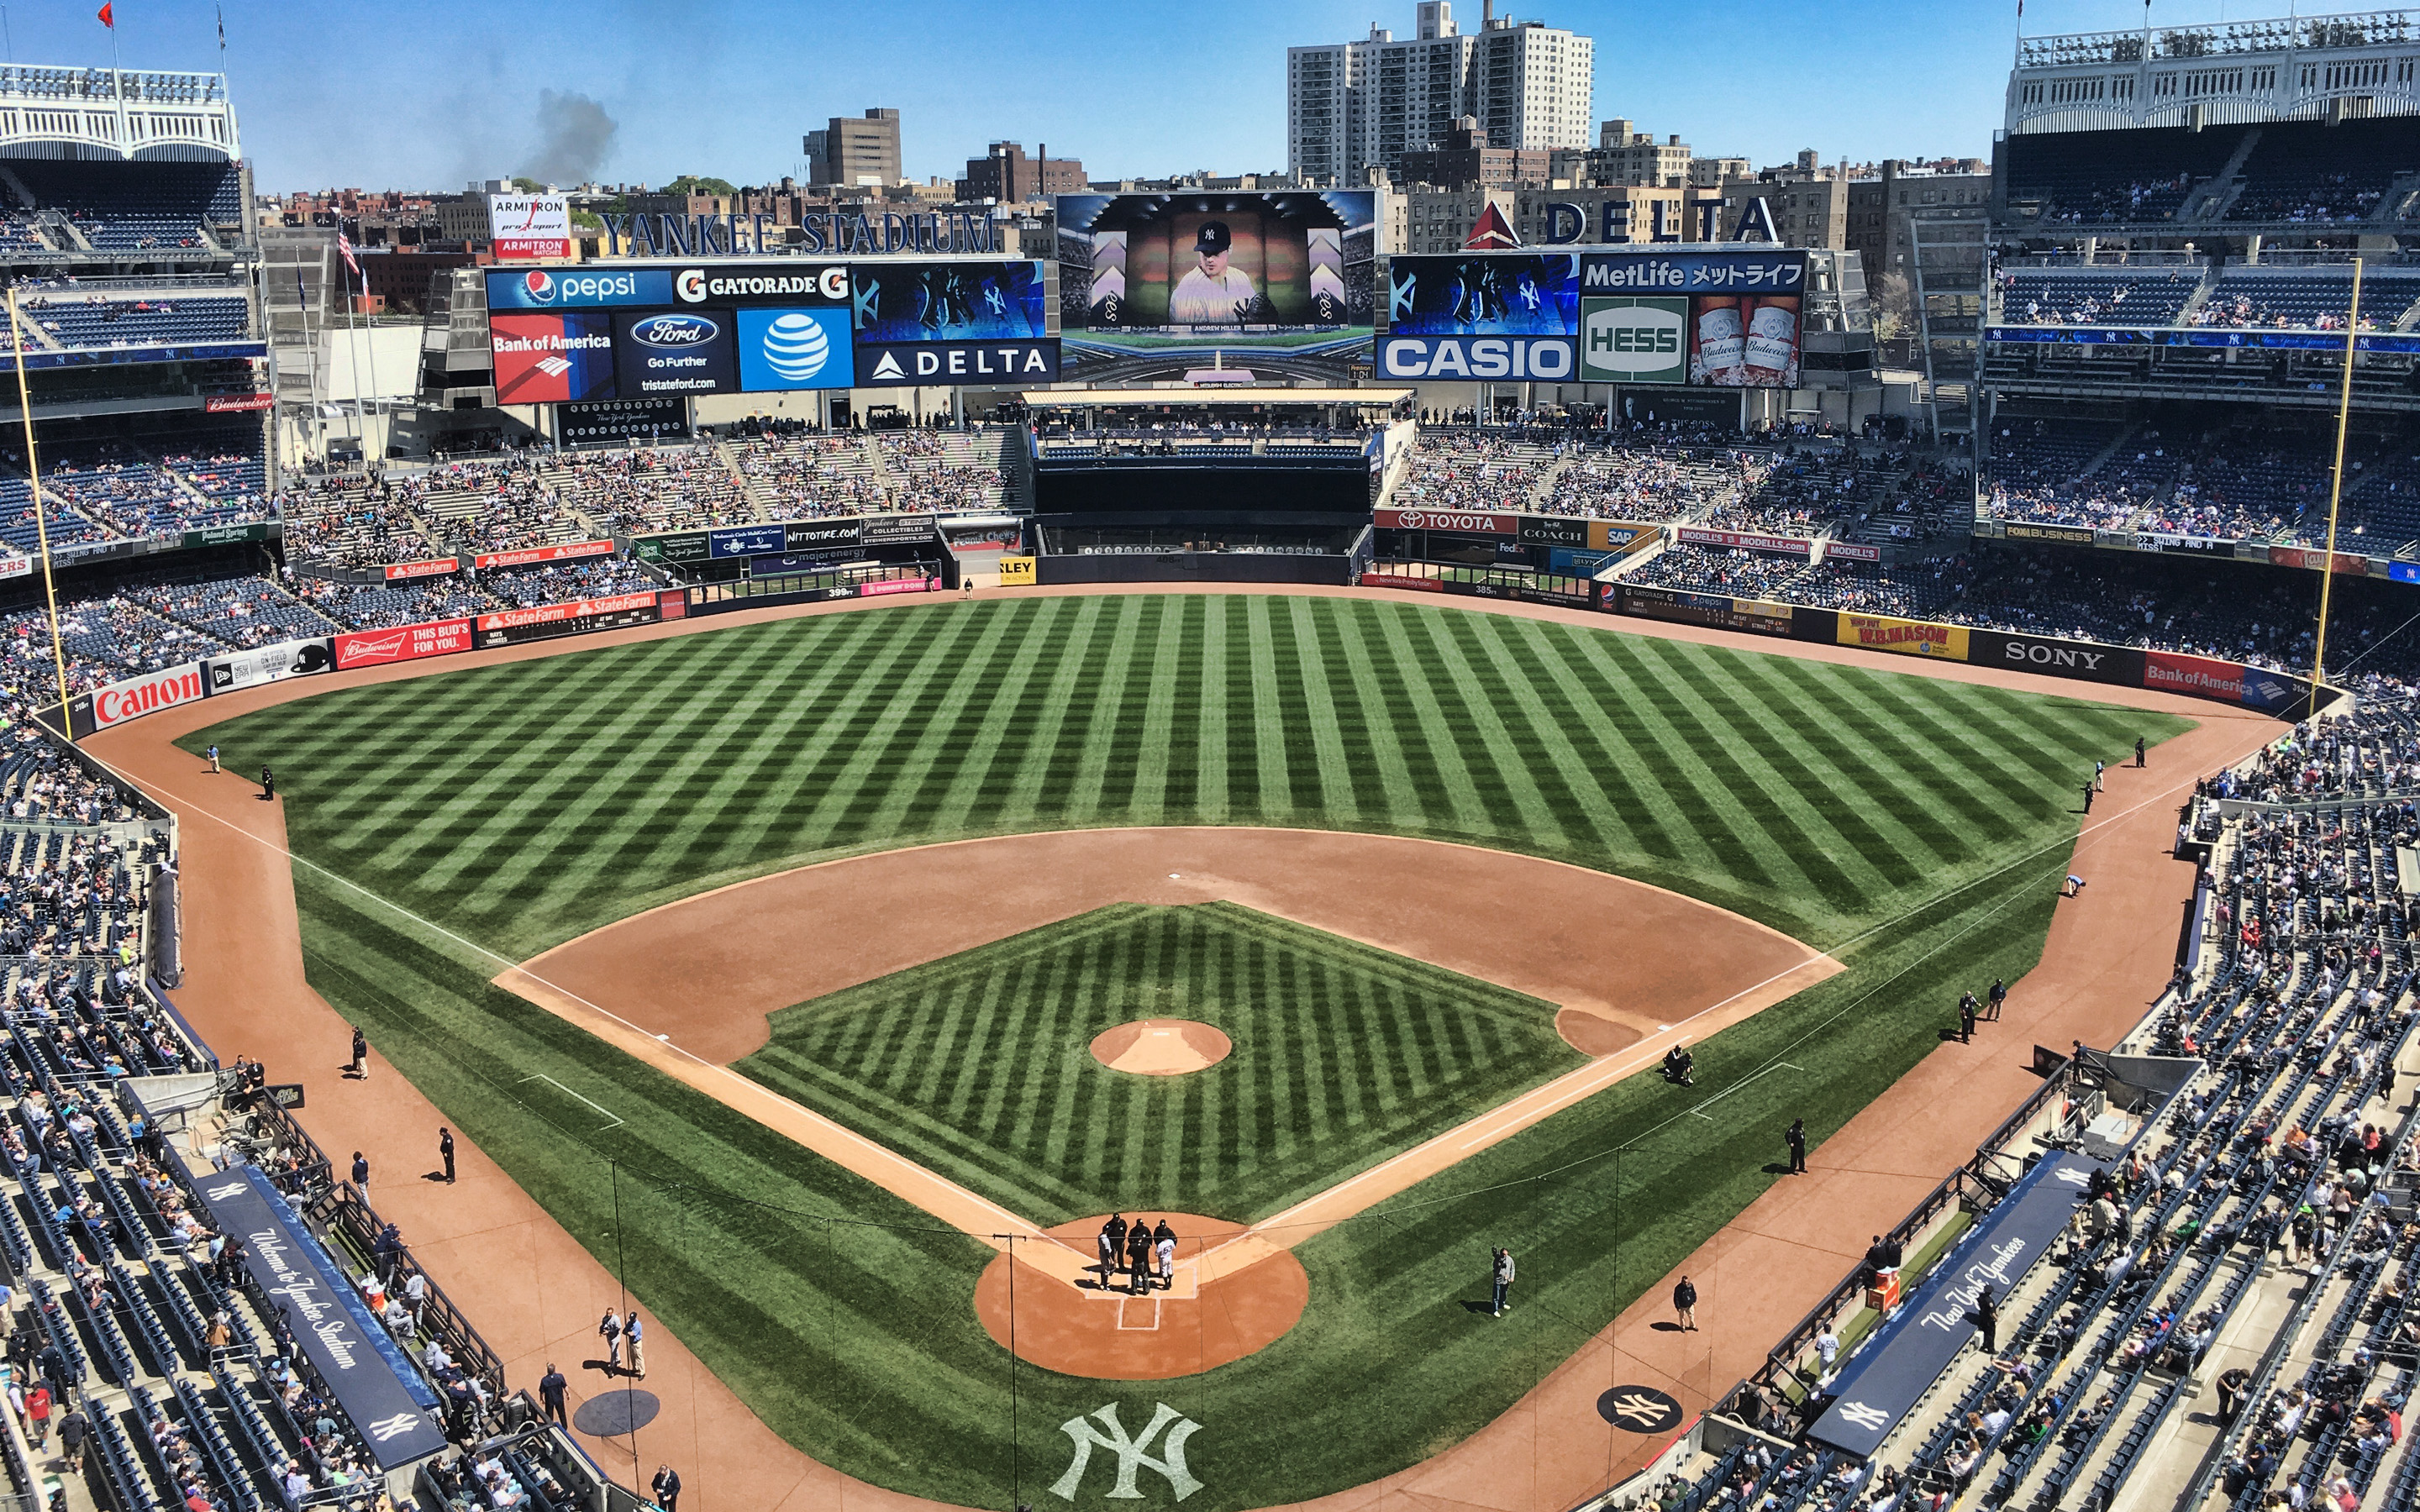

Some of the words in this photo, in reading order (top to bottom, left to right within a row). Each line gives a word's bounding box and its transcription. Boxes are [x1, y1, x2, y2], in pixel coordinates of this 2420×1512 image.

[496, 202, 562, 212] ARMITRON
[1547, 197, 1779, 244] DELTA
[597, 213, 777, 256] YANKEE
[801, 213, 998, 253] STADIUM
[502, 241, 562, 250] ARMITRON
[1585, 261, 1684, 286] MetLife
[1693, 264, 1802, 286] メットライフ
[562, 273, 636, 301] pepsi
[709, 276, 816, 295] GATORADE
[649, 319, 702, 343] Ford
[494, 337, 532, 353] Bank
[534, 336, 549, 349] of
[551, 334, 611, 349] America
[1591, 328, 1677, 353] HESS
[648, 359, 665, 368] Go
[666, 356, 707, 367] Further
[918, 349, 1047, 375] DELTA
[1385, 339, 1572, 378] CASIO
[642, 379, 715, 391] tristateford.com
[209, 397, 271, 410] Budweiser
[1427, 514, 1495, 530] TOYOTA
[202, 530, 224, 542] Poland
[226, 528, 248, 539] Spring
[787, 527, 859, 543] NITTOTIRE.COM
[954, 535, 984, 547] Peanut
[986, 530, 1015, 541] Chews
[1523, 529, 1581, 541] COACH
[1608, 531, 1632, 543] SAP
[1681, 531, 1723, 543] MODELL'S
[2031, 529, 2092, 542] BUSINESS
[2154, 537, 2181, 547] SWING
[1499, 542, 1525, 554] FedEx
[1739, 538, 1805, 550] MODELLS.com
[1831, 546, 1875, 558] MODELL'S
[66, 549, 89, 559] SWING
[92, 546, 108, 555] AND
[1634, 590, 1665, 599] GATORADE
[1699, 597, 1722, 606] pepsi
[413, 628, 435, 641] THIS
[438, 622, 468, 638] BUD'S
[346, 639, 401, 657] Budweiser
[413, 641, 433, 654] FOR
[435, 637, 460, 650] YOU.
[260, 654, 287, 664] ON-FIELD
[2006, 642, 2104, 669] SONY
[2149, 666, 2183, 682] Bank
[2185, 672, 2198, 685] of
[2200, 674, 2253, 696] America
[96, 671, 201, 723] Canon
[249, 1228, 290, 1276] Welcome
[277, 1270, 294, 1284] to
[1921, 1306, 1965, 1331] New
[1973, 1236, 2026, 1284] Yankees
[270, 1277, 332, 1321] Yankee
[313, 1320, 356, 1370] Stadium
